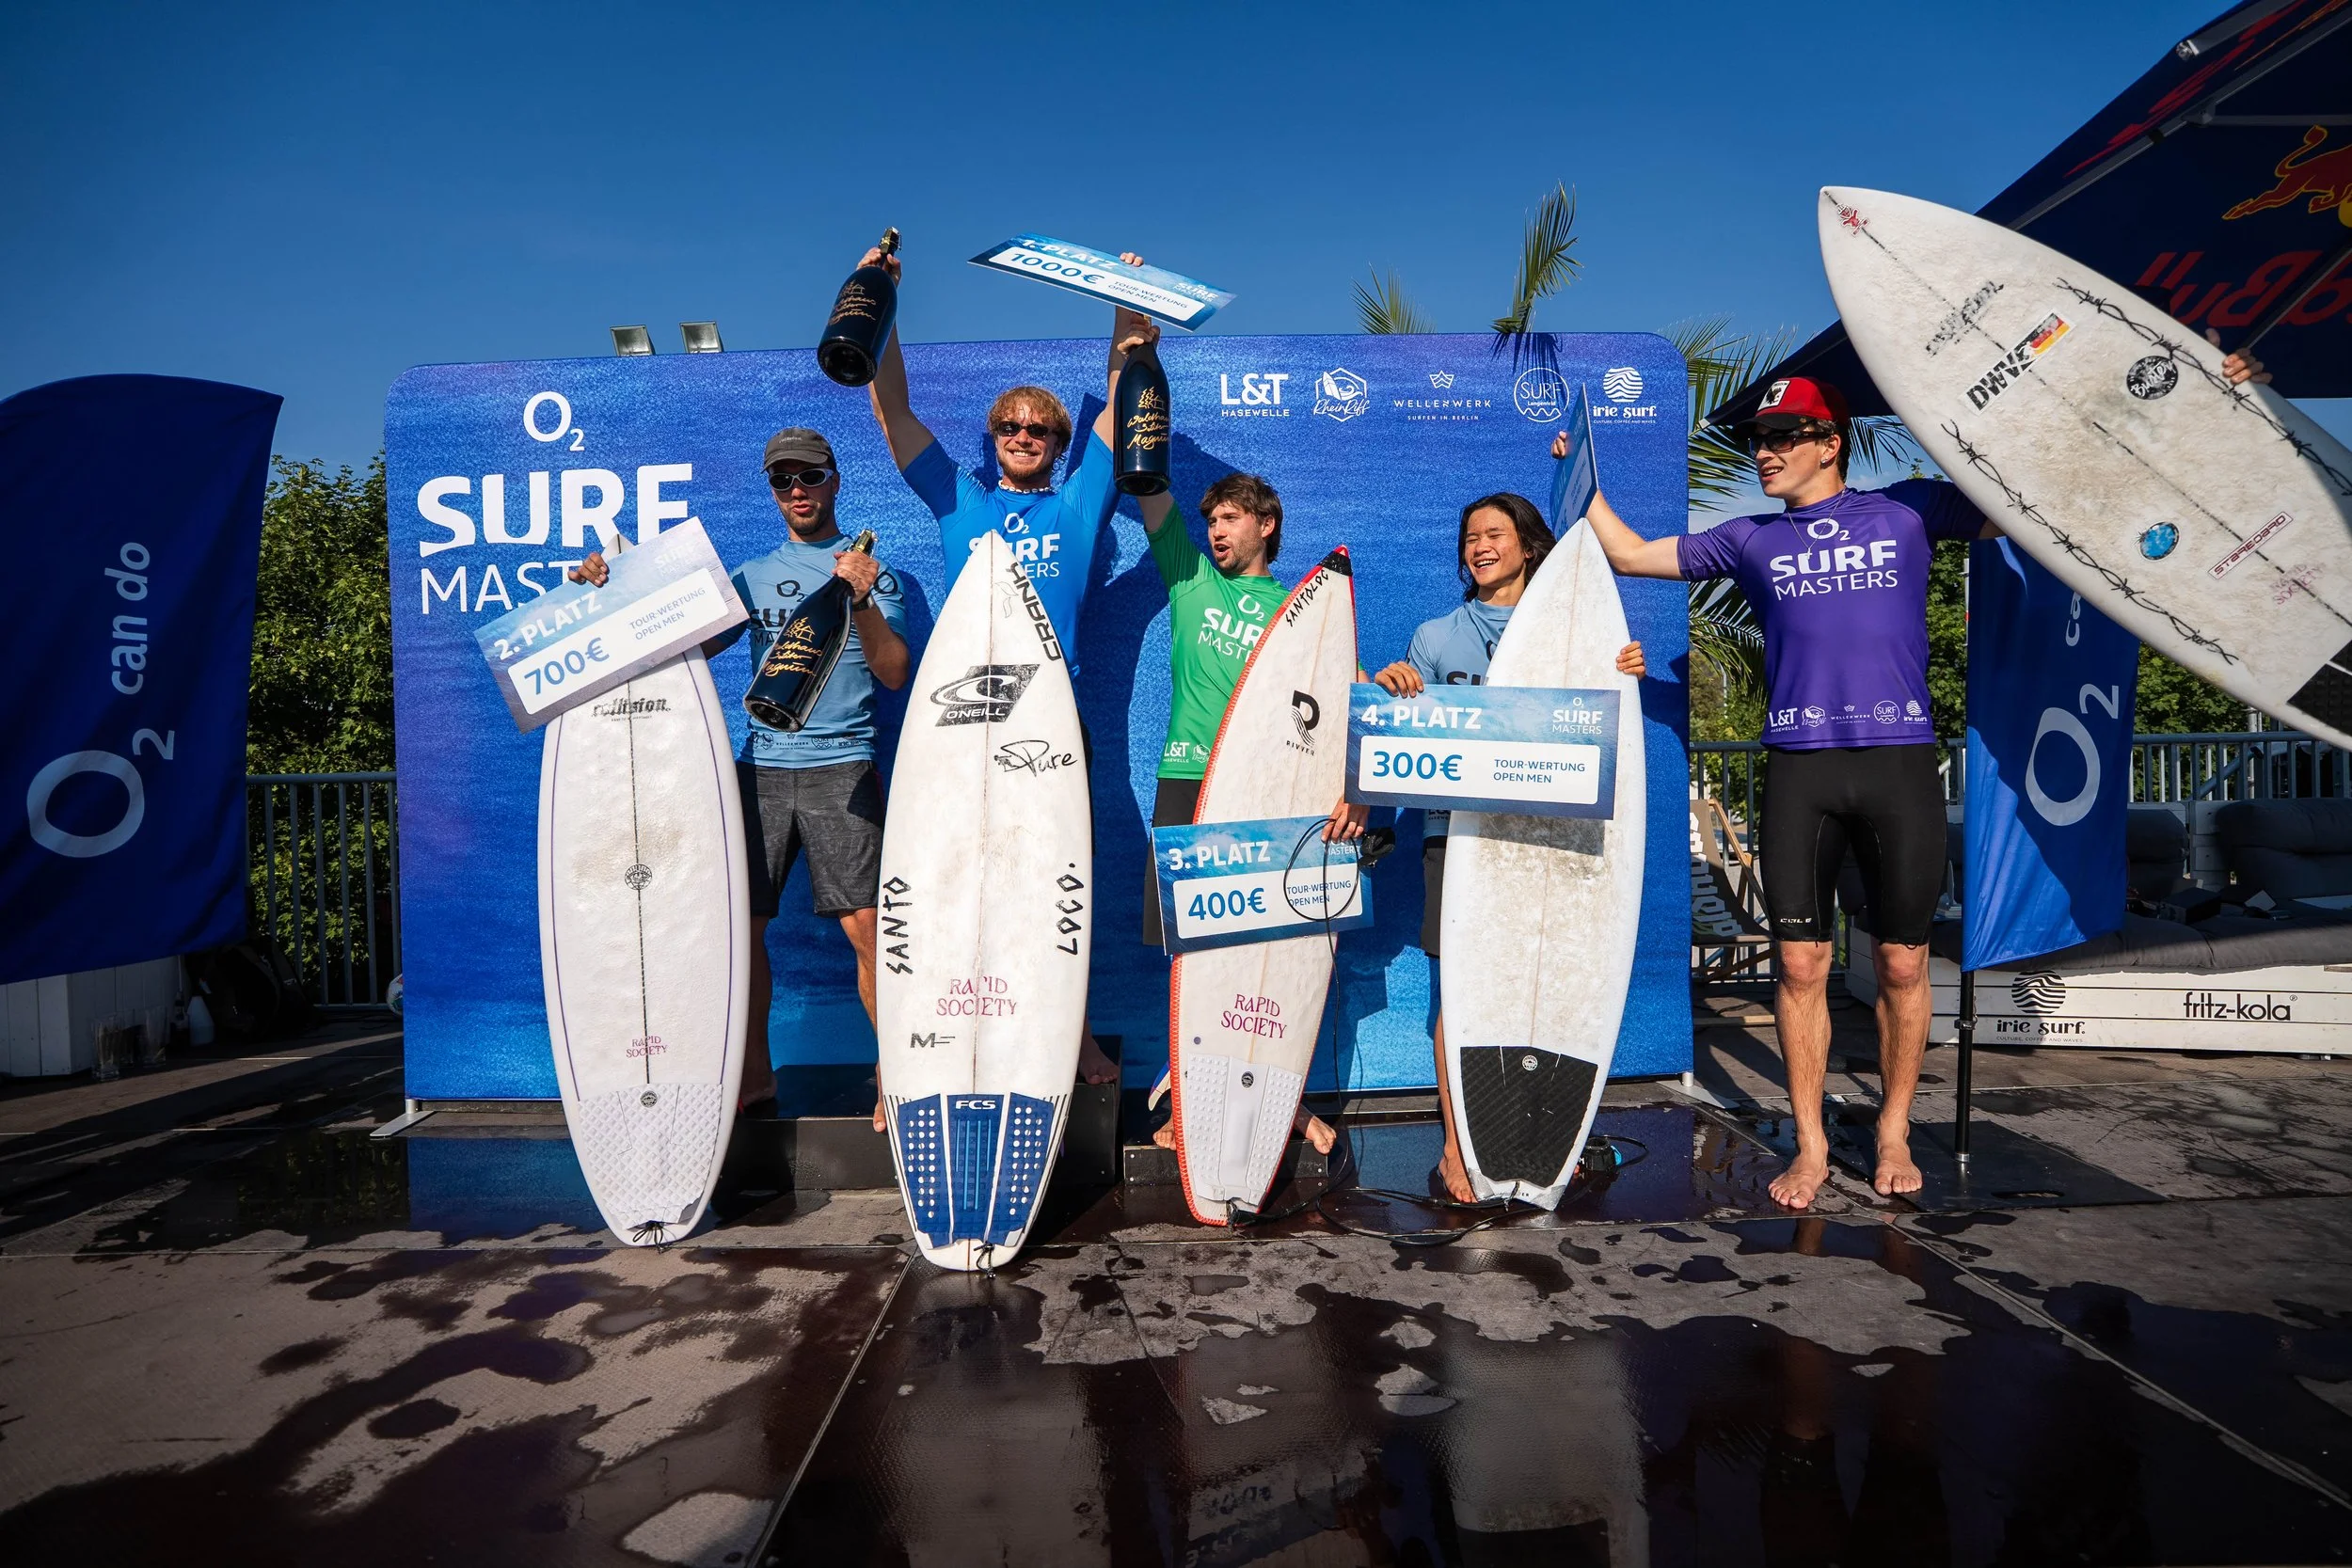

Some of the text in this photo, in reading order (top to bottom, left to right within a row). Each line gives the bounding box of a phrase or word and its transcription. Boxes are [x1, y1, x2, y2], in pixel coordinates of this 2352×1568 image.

[1021, 239, 1119, 270] 1. PLATZ
[1010, 252, 1104, 285] 1000€
[1107, 284, 1157, 304] OPEN MEN
[1114, 280, 1188, 309] TOUR-WERTUNG
[1175, 281, 1220, 299] SURF
[1219, 372, 1289, 405] L&T
[1519, 381, 1563, 400] SURF
[1221, 408, 1290, 418] HASEWELLE
[1393, 399, 1491, 408] WELLENWERK
[1593, 405, 1618, 418] irie
[416, 463, 693, 557] SURF
[1770, 539, 1898, 582] SURF
[421, 561, 585, 614] MAST
[1774, 570, 1899, 601] MASTERS
[103, 541, 151, 696] can do
[628, 586, 707, 630] TOUR-WERTUNG
[493, 590, 602, 660] 2. PLATZ
[635, 610, 686, 641] OPEN MEN
[1201, 608, 1267, 647] SUR
[523, 637, 611, 696] 700€
[946, 706, 1007, 720] O'NEILL
[1361, 705, 1483, 730] 4. PLATZ
[1551, 709, 1603, 724] SURF
[1769, 707, 1799, 728] L&T
[1877, 705, 1897, 716] SURF
[1551, 724, 1602, 735] MASTERS
[1164, 741, 1190, 758] L&T
[1372, 751, 1464, 782] 300€
[1494, 758, 1586, 772] TOUR-WERTUNG
[1493, 772, 1552, 784] OPEN MEN
[1168, 841, 1271, 871] 3. PLATZ
[1286, 879, 1352, 895] TOUR-WERTUNG
[1187, 887, 1267, 921] 400€
[1288, 895, 1330, 907] OPEN MEN
[882, 874, 913, 974] SANTO
[936, 997, 1018, 1017] SOCIETY
[1233, 993, 1281, 1017] RAPID
[1220, 1010, 1288, 1038] SOCIETY
[1996, 1019, 2030, 1033] irie
[626, 1045, 668, 1058] SOCIETY
[955, 1099, 997, 1110] FCS
